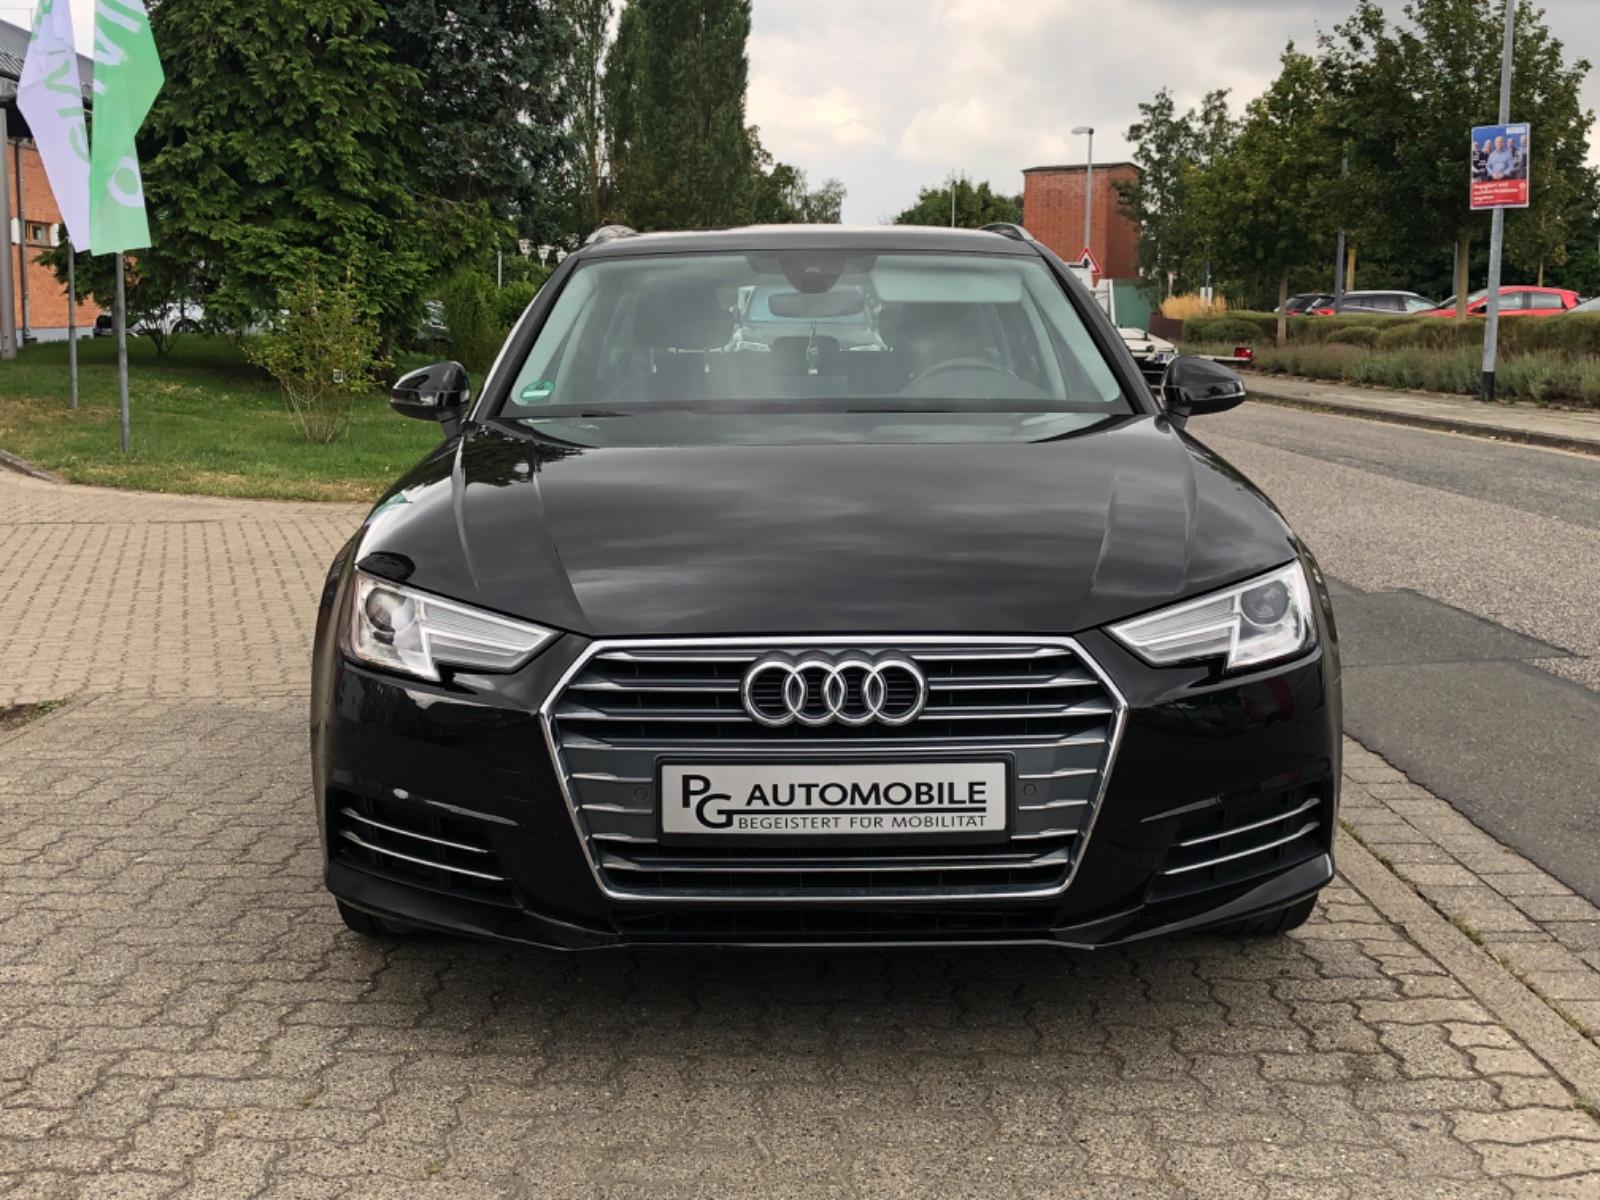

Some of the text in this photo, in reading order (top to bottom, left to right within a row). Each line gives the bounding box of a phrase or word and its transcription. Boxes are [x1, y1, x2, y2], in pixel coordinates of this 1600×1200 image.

[682, 774, 987, 829] PG AUTOMOBILE
[739, 815, 987, 829] BEGEISTERT FÜR MOBILITÄT
